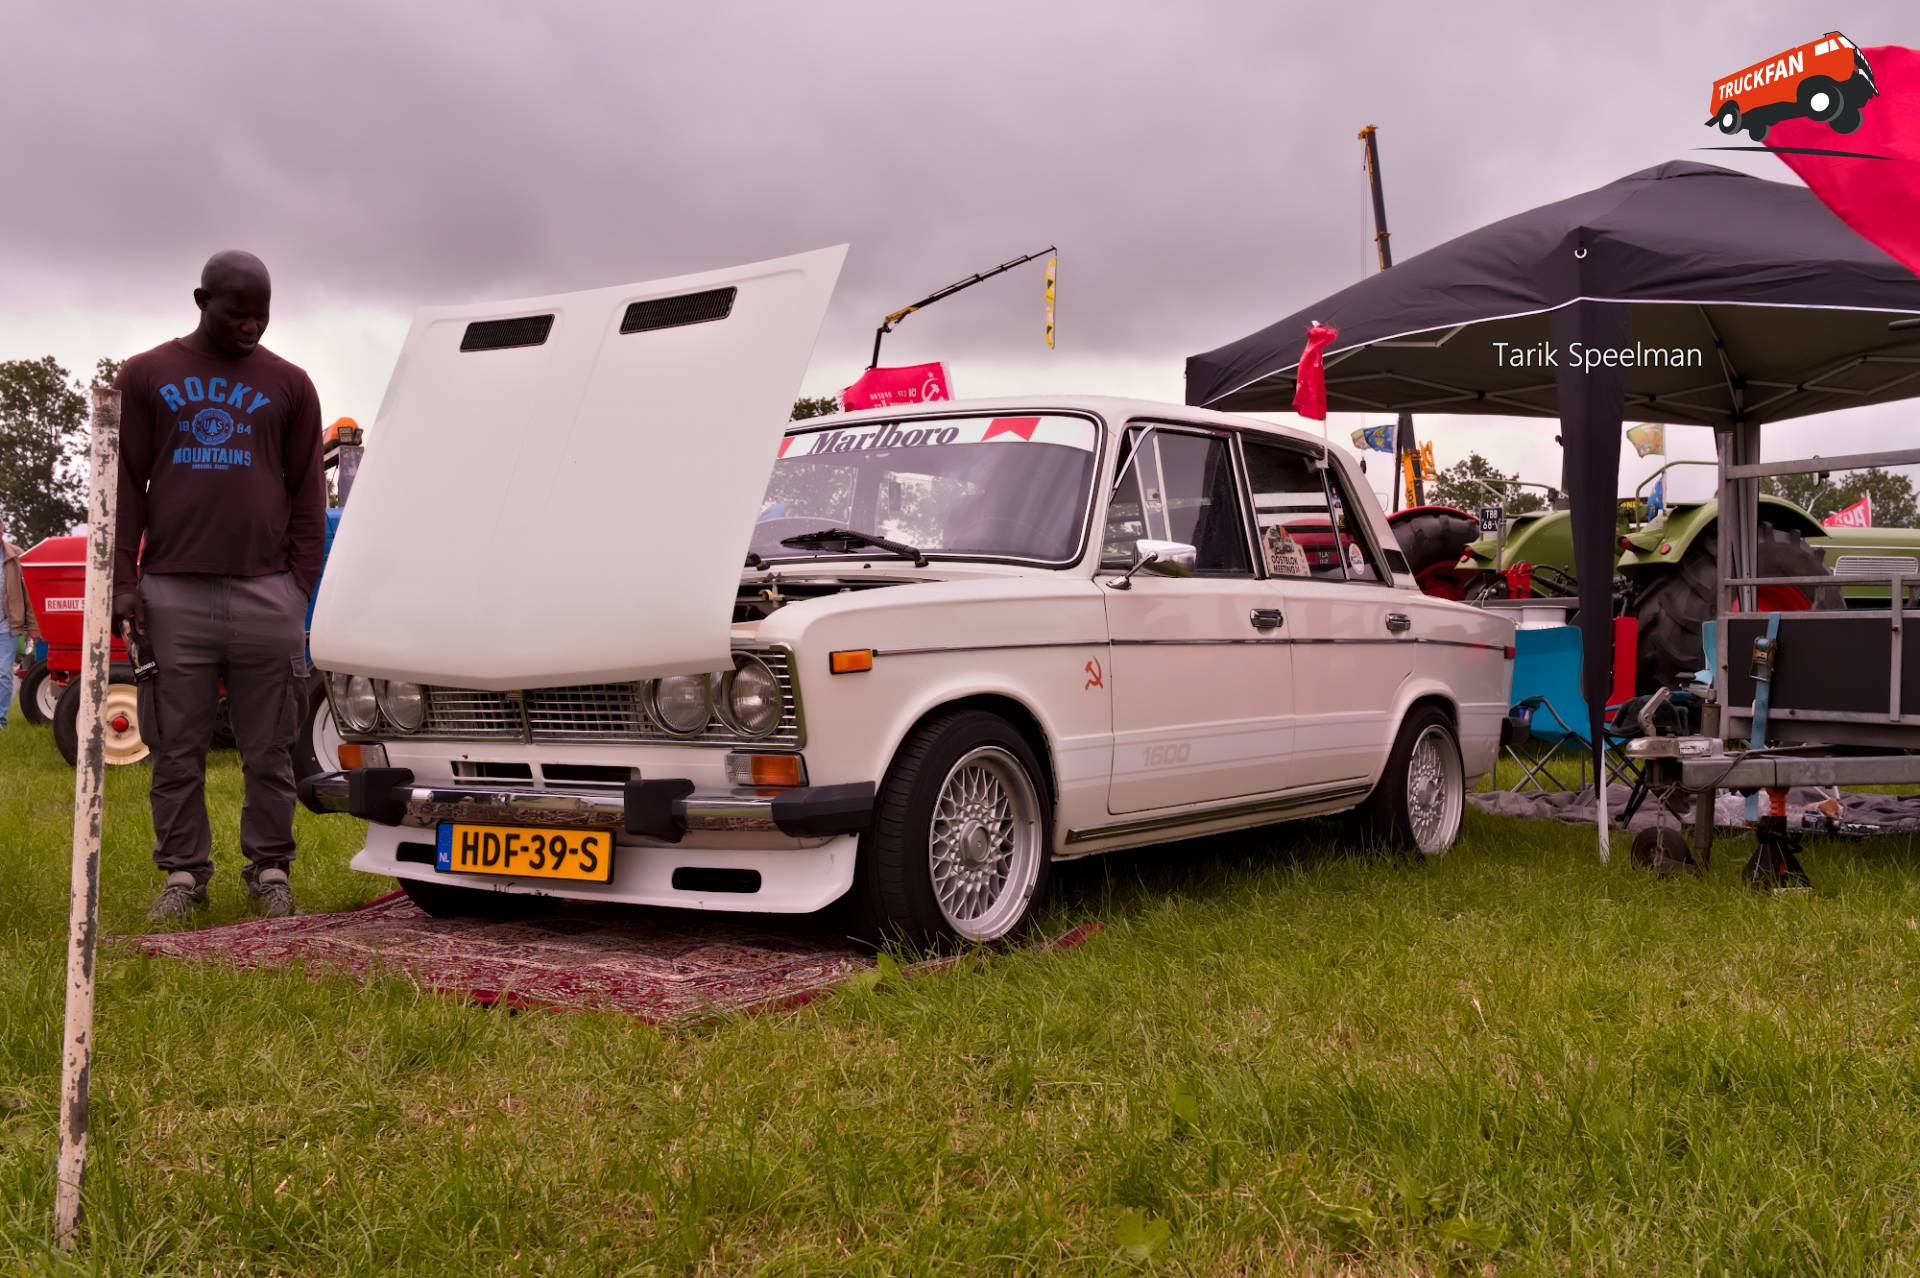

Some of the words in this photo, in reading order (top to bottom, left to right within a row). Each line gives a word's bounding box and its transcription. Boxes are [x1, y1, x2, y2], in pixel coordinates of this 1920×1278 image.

[160, 376, 271, 414] ROCKY
[808, 423, 960, 454] Marlboro
[173, 448, 252, 467] MOUNTAINS
[47, 599, 80, 609] RENAULT
[1142, 743, 1191, 767] 1600
[439, 852, 450, 863] NL
[461, 831, 598, 873] HDF-39-S
